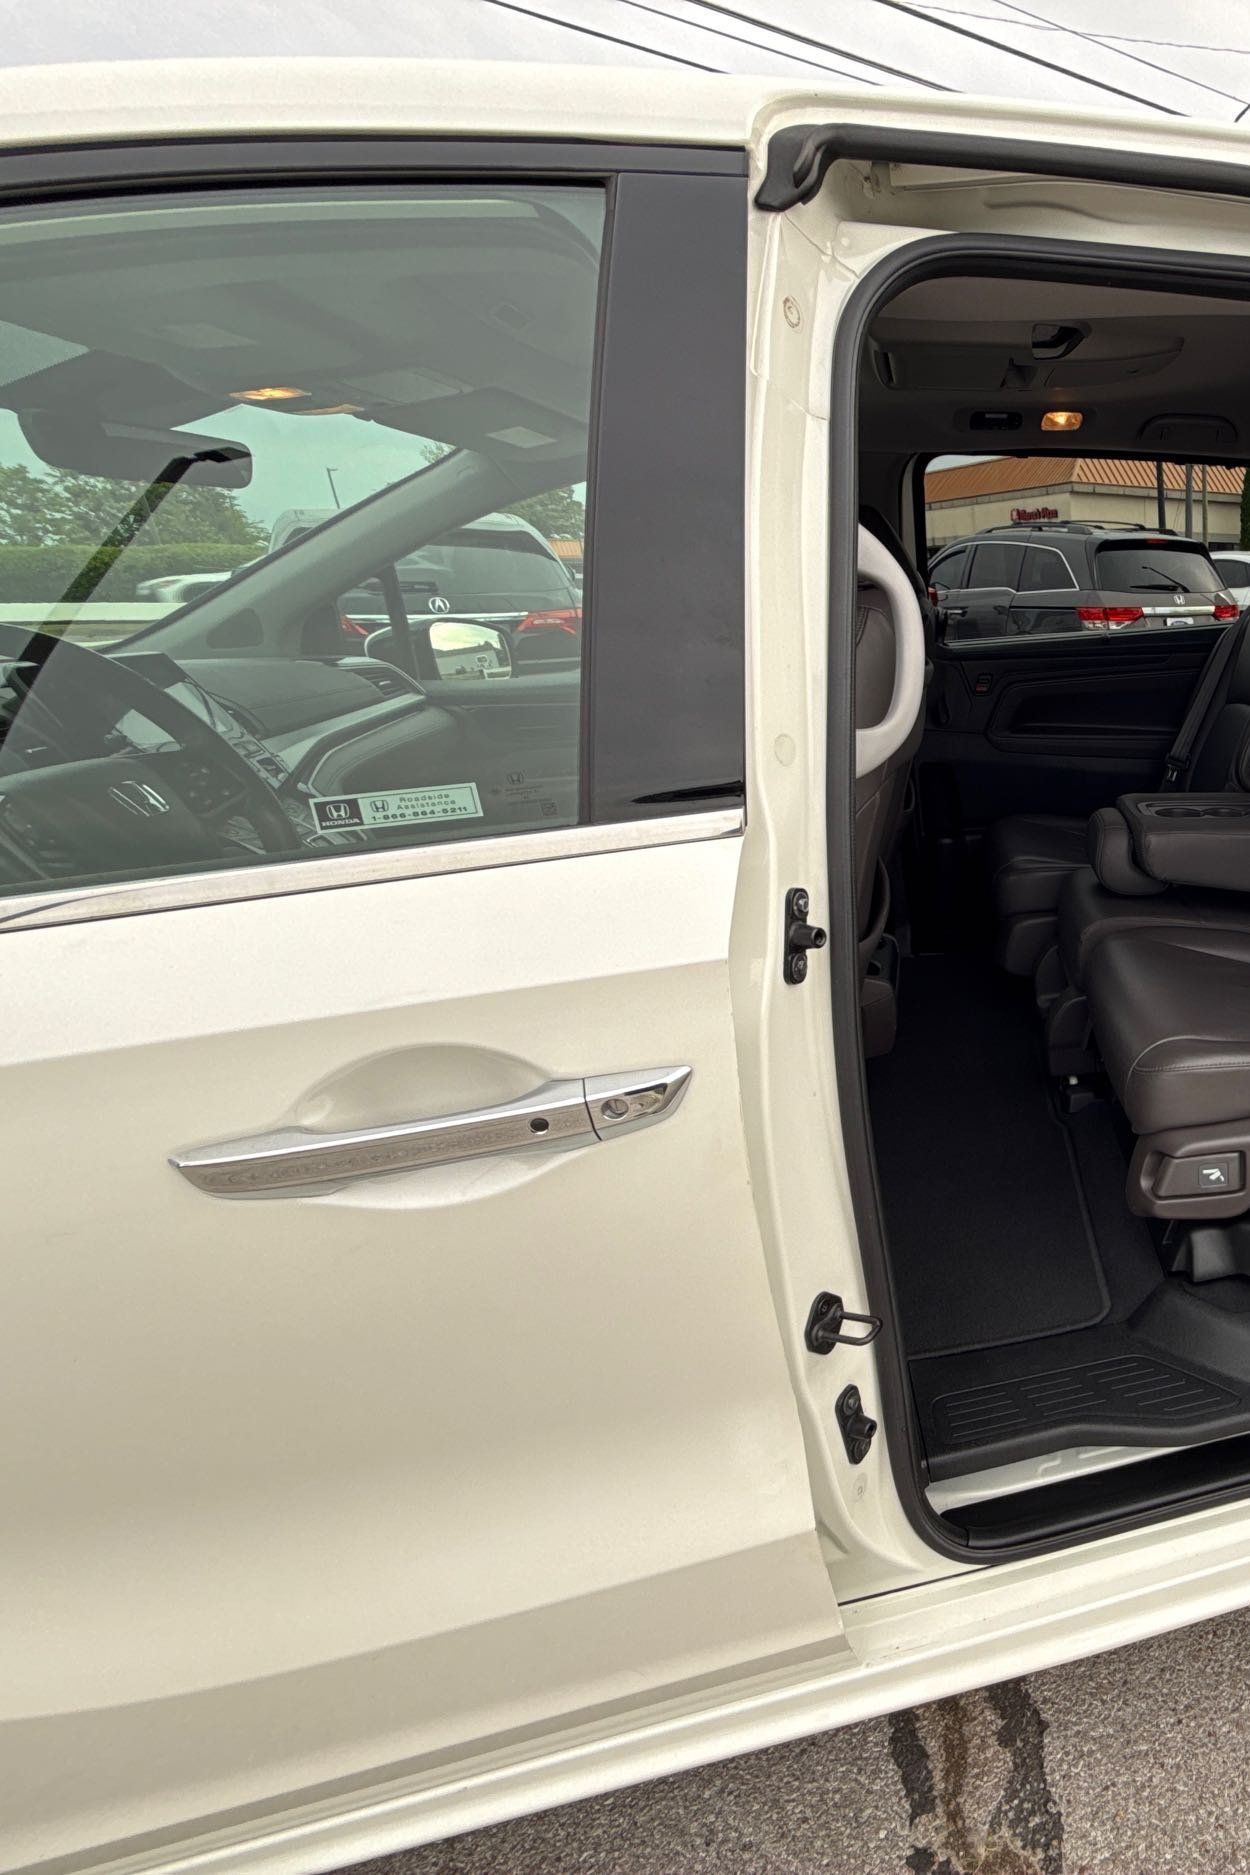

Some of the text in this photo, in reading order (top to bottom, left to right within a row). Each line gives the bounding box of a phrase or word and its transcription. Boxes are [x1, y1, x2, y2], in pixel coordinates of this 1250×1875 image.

[399, 793, 450, 804] Roadside
[397, 799, 456, 810] Assistance
[371, 806, 468, 822] 1-866-864-5211
[321, 818, 361, 827] HONDA
